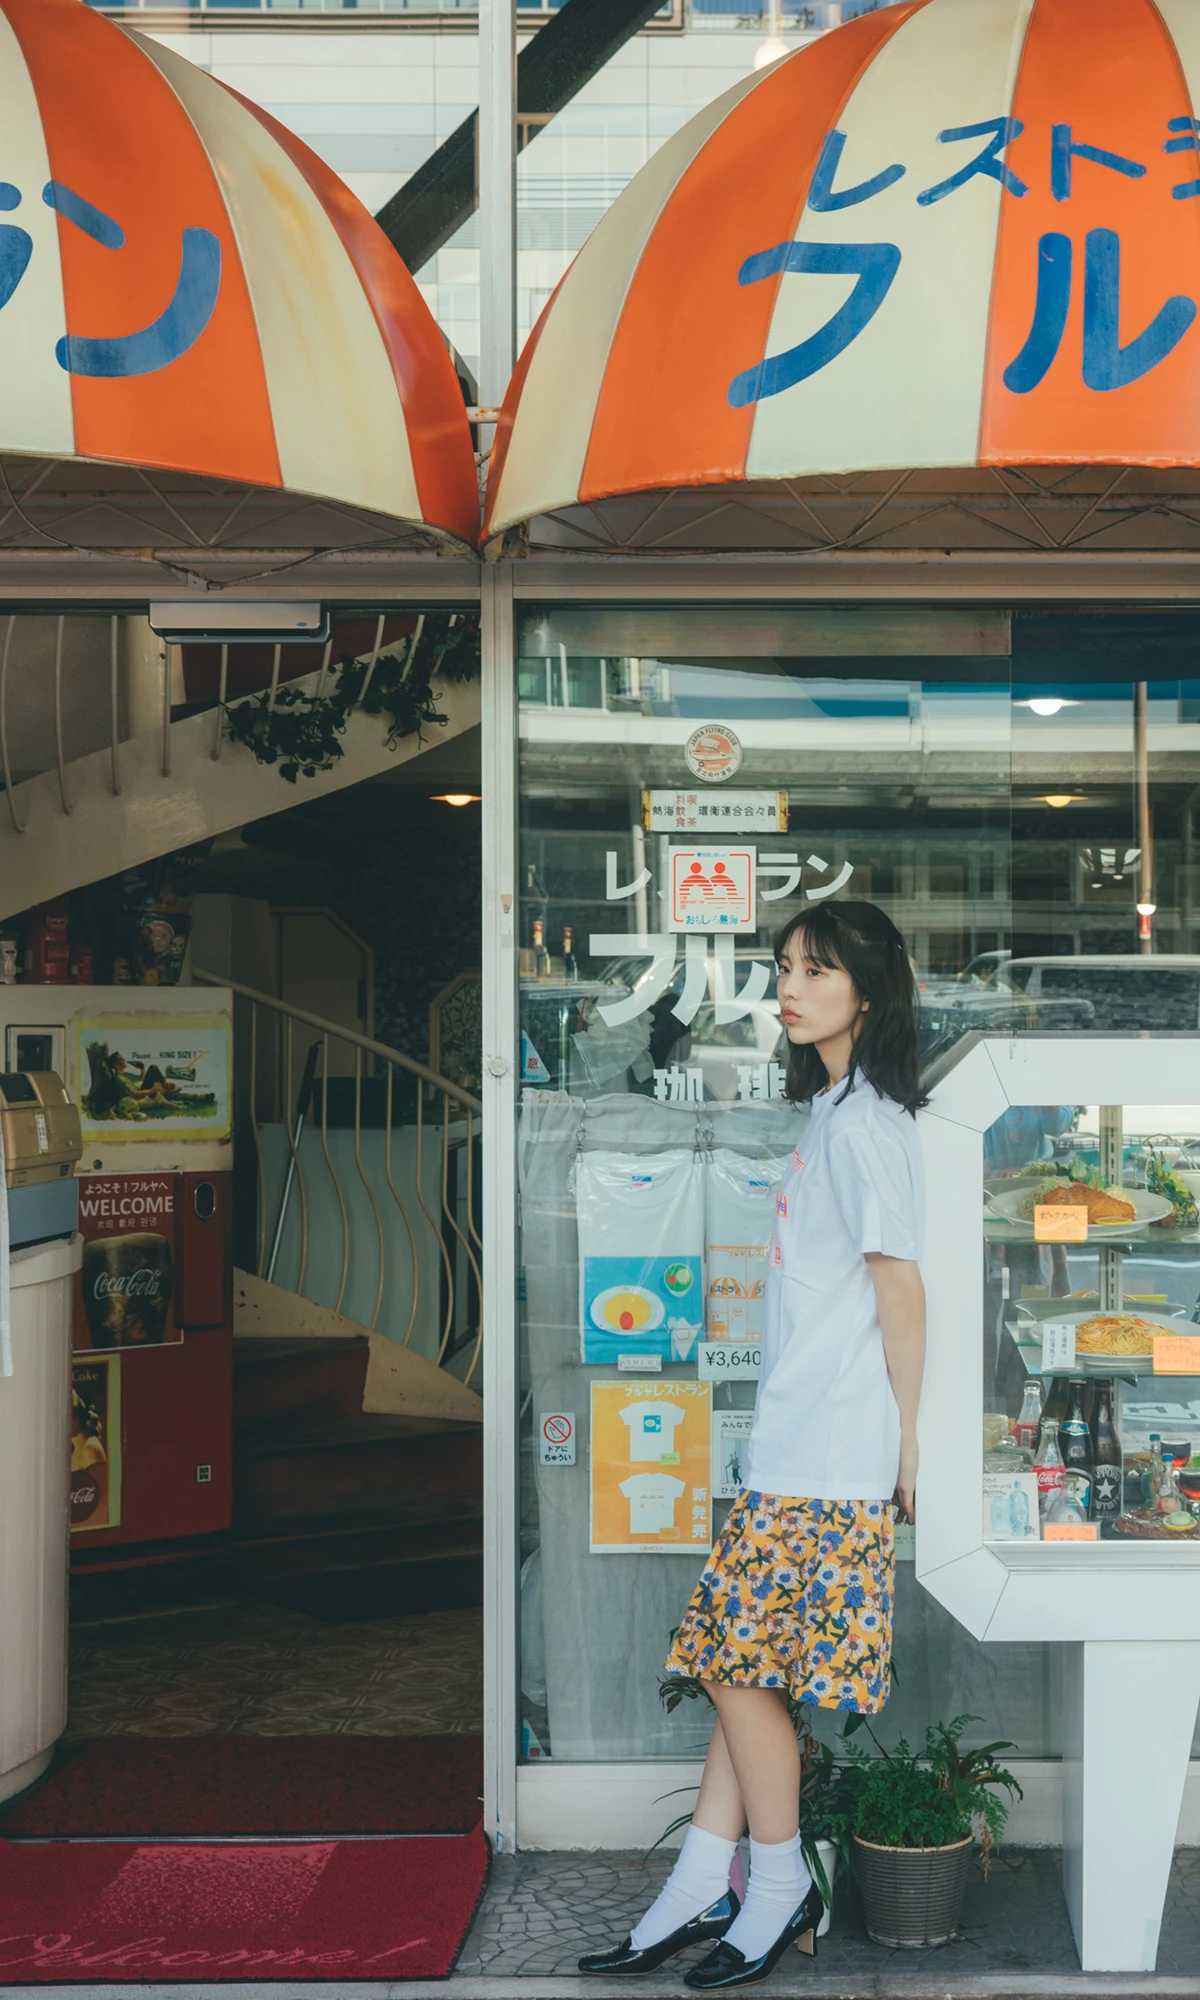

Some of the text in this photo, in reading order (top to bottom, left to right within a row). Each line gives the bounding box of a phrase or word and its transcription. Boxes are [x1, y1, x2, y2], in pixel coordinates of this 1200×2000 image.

[726, 227, 1198, 409] フル
[690, 727, 738, 747] JAPAN FLYING CLUB
[605, 850, 854, 901] レラン
[685, 914, 739, 926] おもしろ熱海
[589, 933, 780, 1028] フル
[159, 1051, 176, 1059] KING
[80, 1196, 174, 1217] WELCOME
[140, 1216, 158, 1228] 환영
[93, 1268, 162, 1300] Coca-Cola
[705, 1351, 761, 1369] ¥3,640
[72, 1368, 99, 1382] Coke
[543, 1453, 572, 1462] ちゅうい
[548, 1445, 569, 1453] ドアに
[1037, 1471, 1064, 1488] Coca-C
[70, 1487, 96, 1504] Cola
[691, 1487, 707, 1539] 新発売
